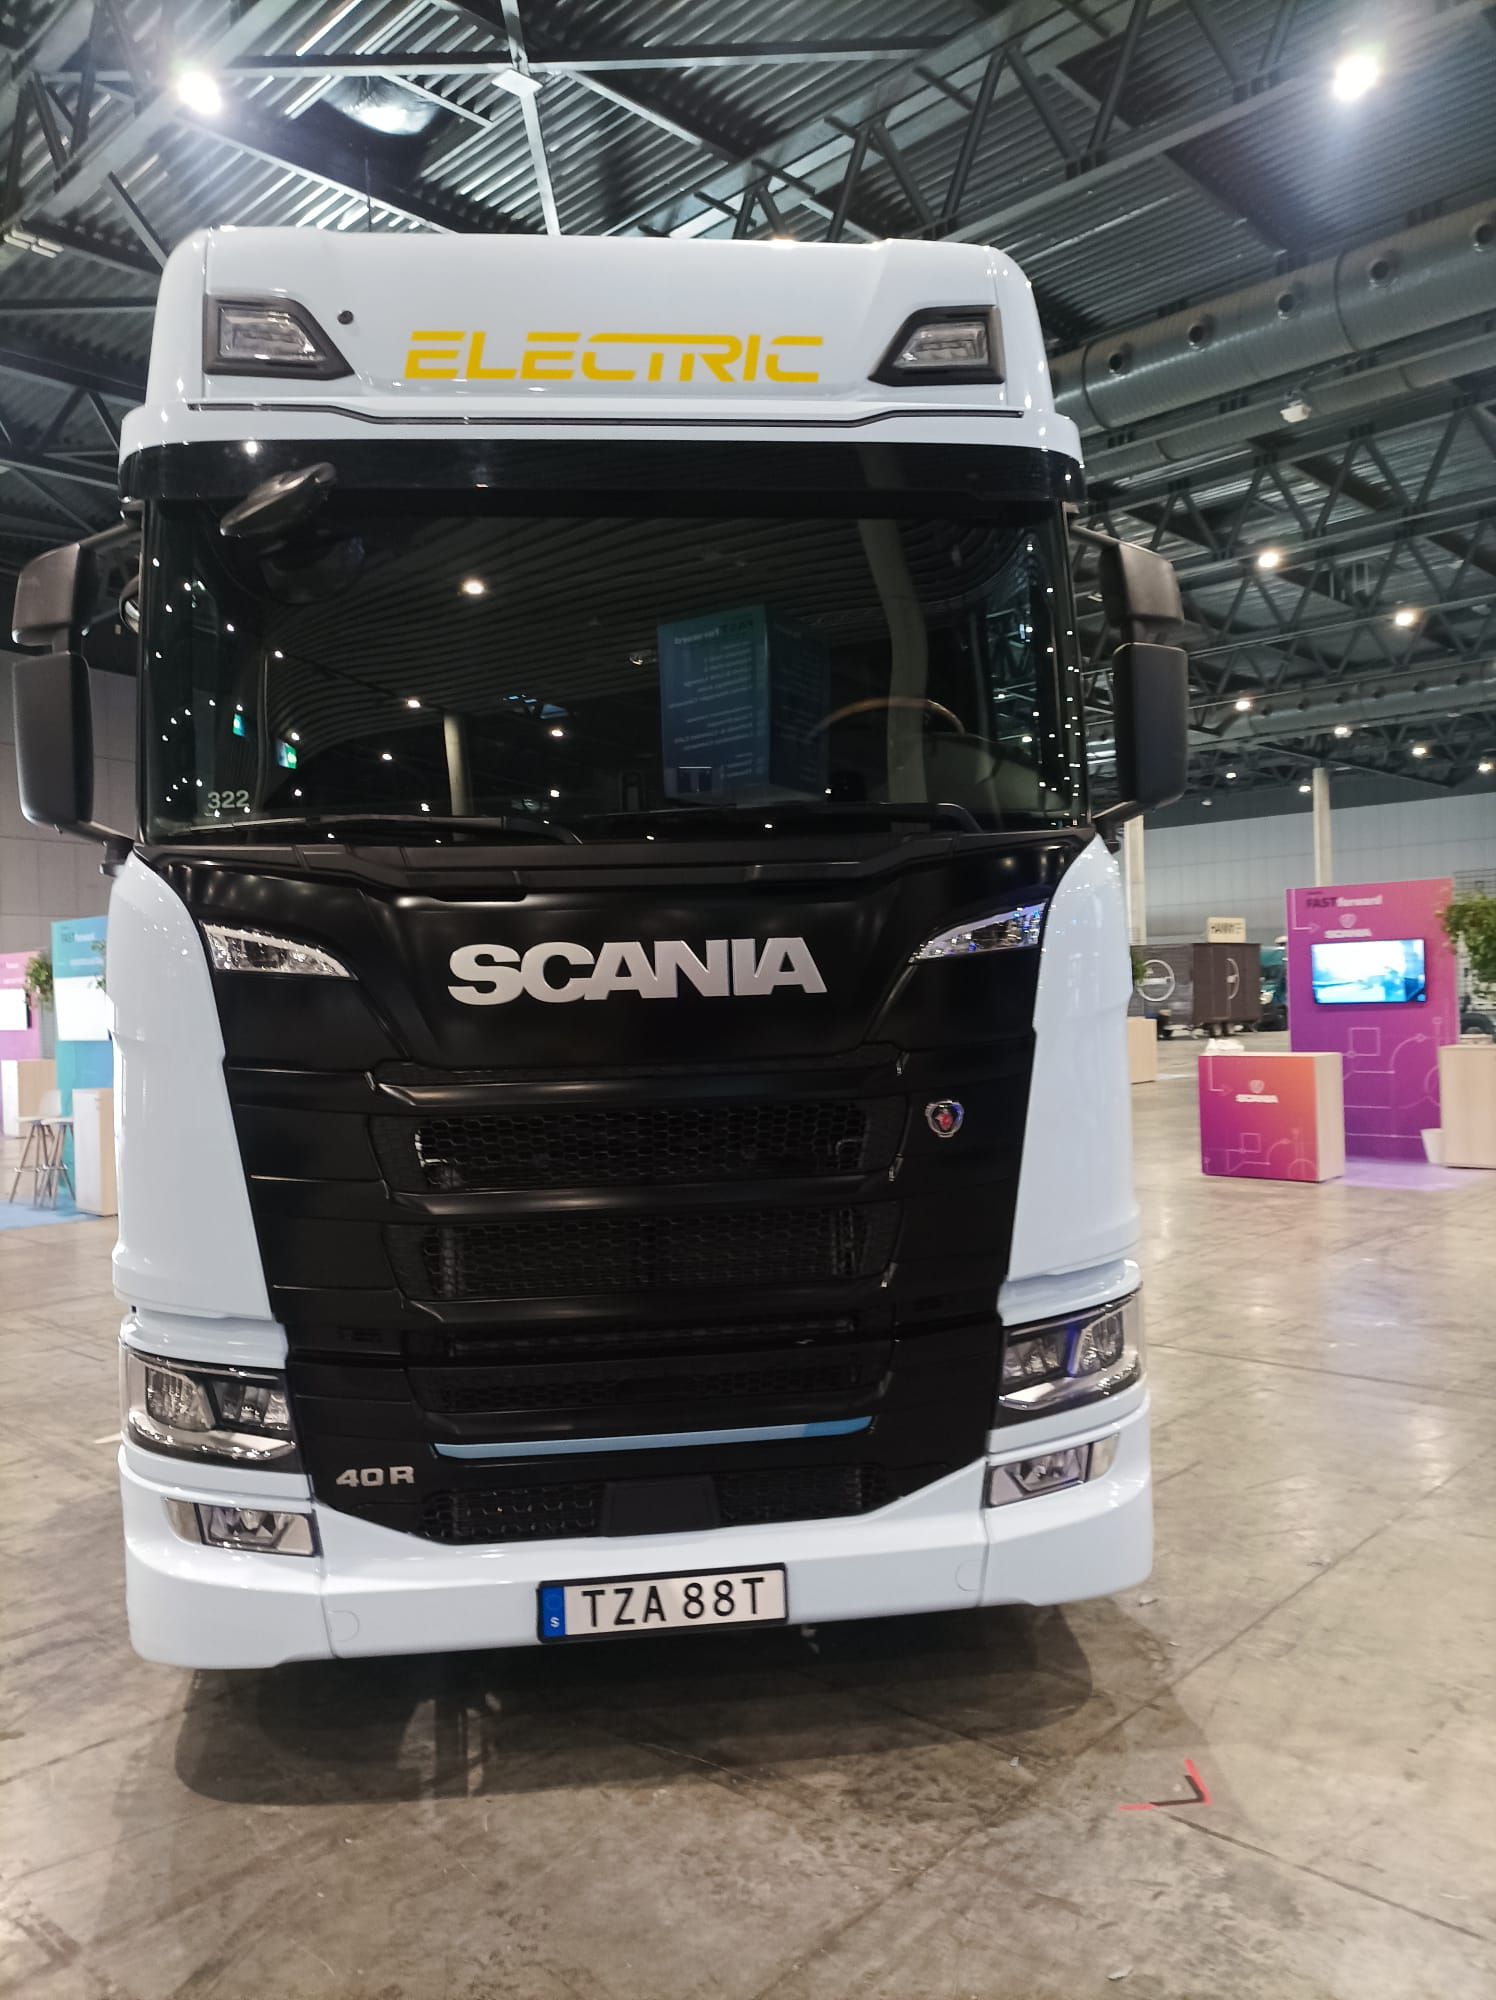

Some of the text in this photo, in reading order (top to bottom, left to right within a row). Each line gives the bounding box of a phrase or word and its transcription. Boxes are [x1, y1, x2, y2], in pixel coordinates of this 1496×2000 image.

[404, 331, 823, 382] ELECTRIC
[207, 790, 249, 809] 322
[448, 937, 827, 1005] SCANIA
[550, 1616, 560, 1629] S
[582, 1577, 765, 1628] TZA 88T
